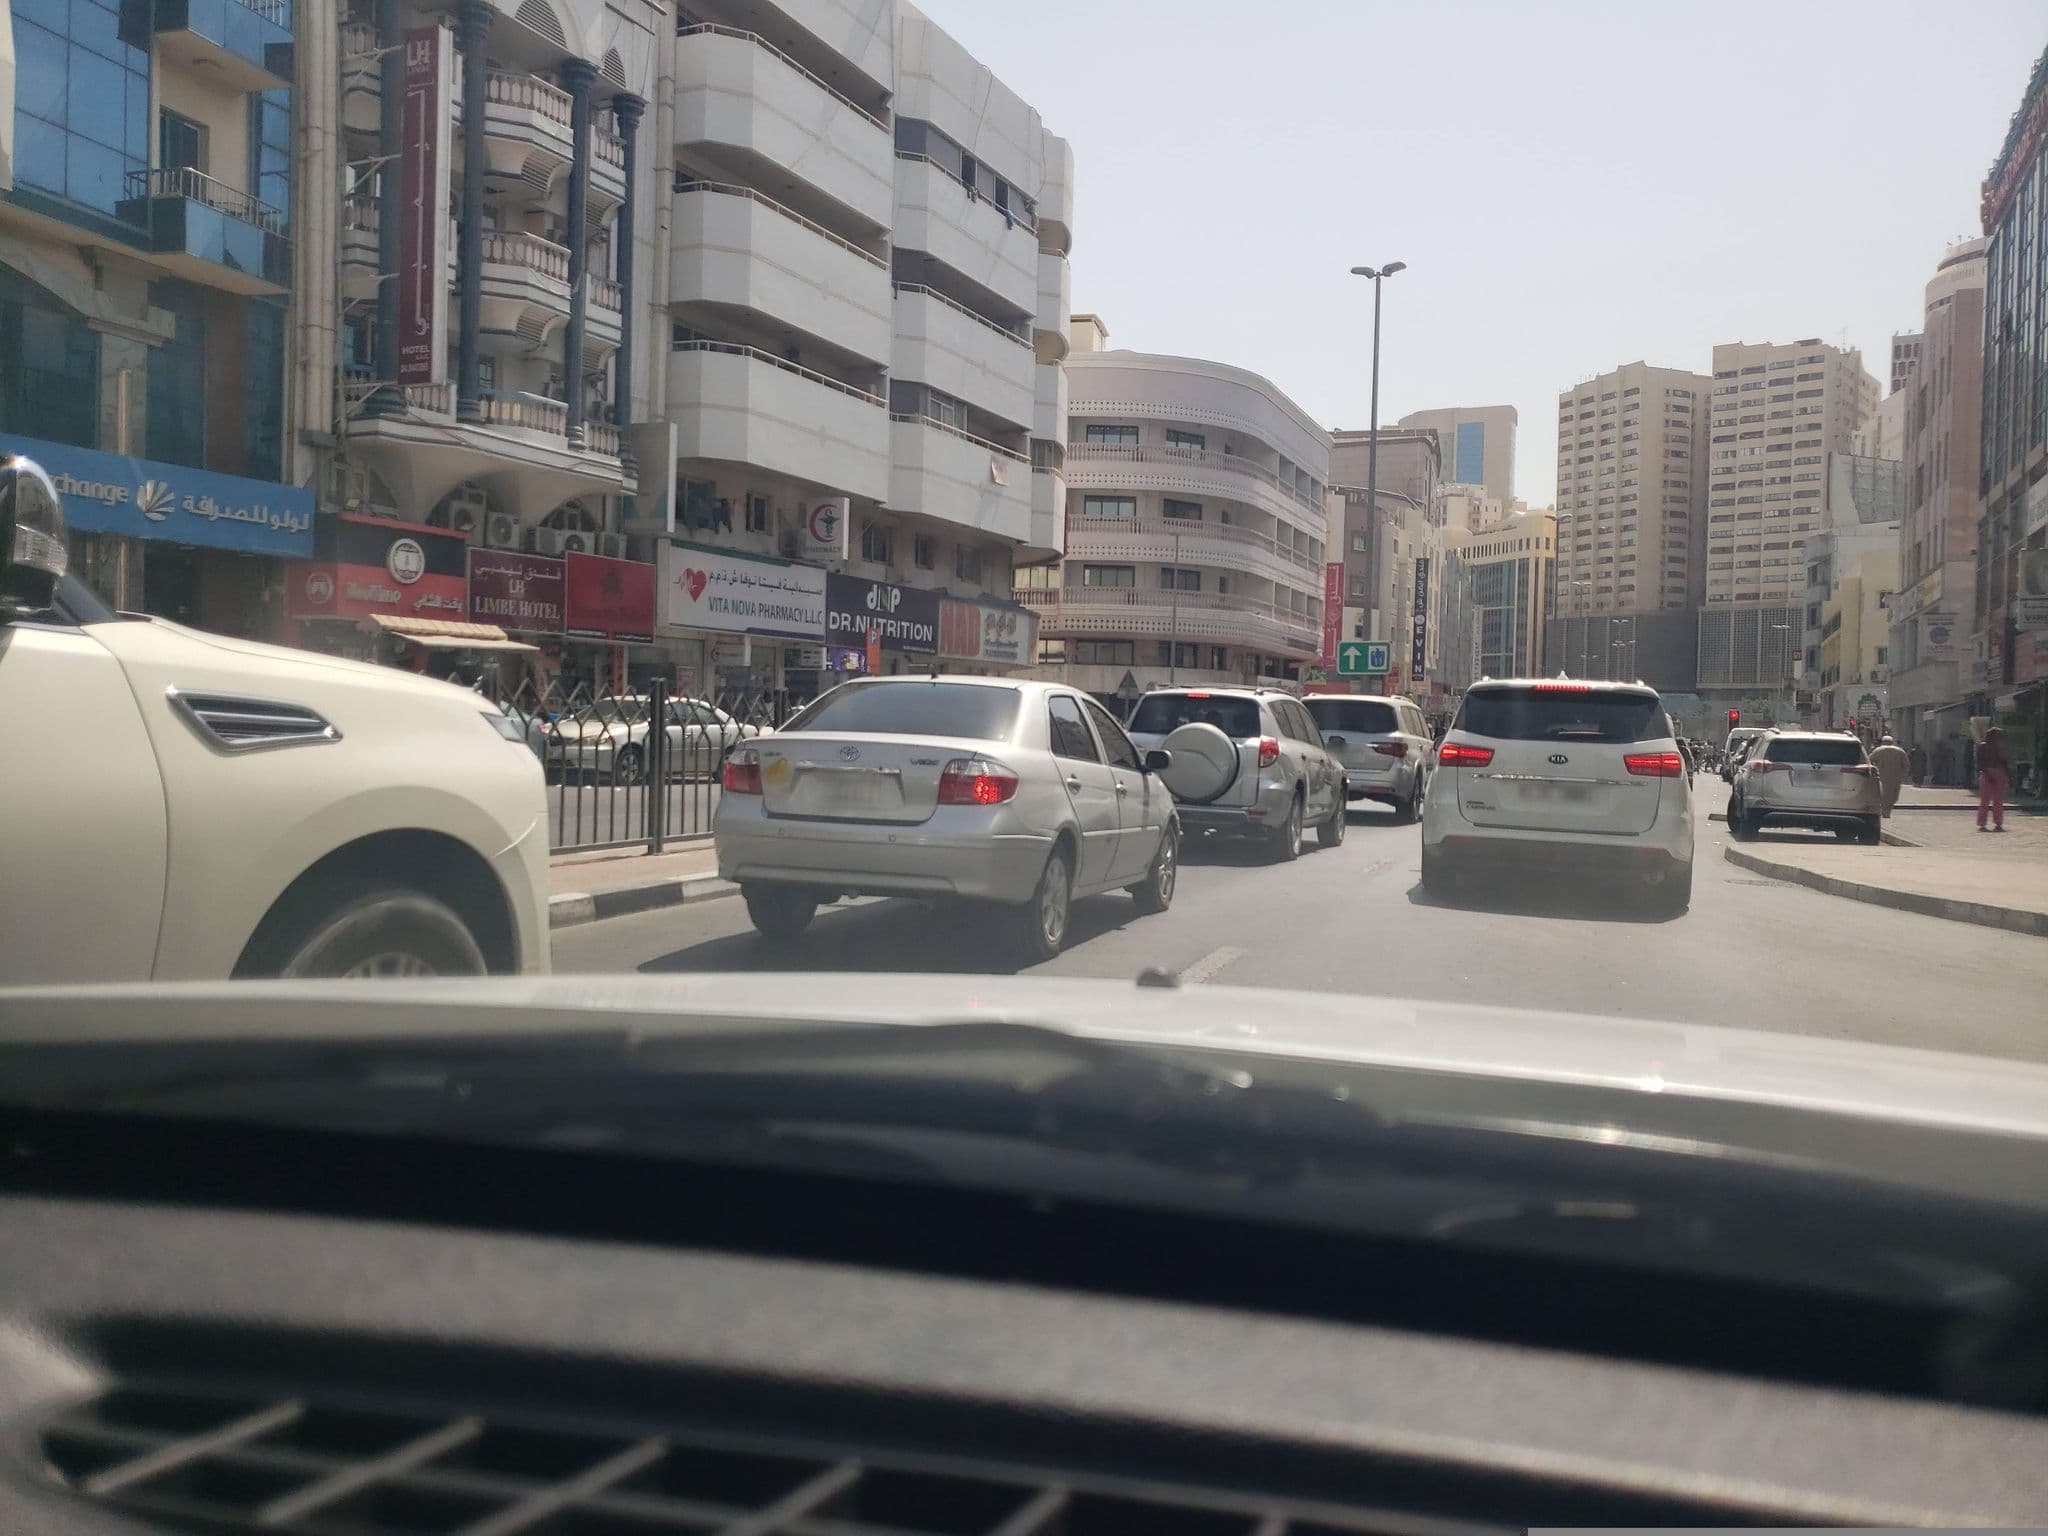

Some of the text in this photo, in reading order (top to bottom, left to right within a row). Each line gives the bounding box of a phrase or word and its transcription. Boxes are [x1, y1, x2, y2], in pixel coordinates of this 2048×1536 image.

[401, 344, 430, 354] HOTEL
[51, 474, 128, 507] change
[270, 509, 310, 533] لولو
[475, 596, 517, 616] LIMBE
[519, 600, 560, 619] HOTEL
[708, 595, 729, 614] VITA
[732, 599, 756, 617] NOVA
[758, 602, 803, 623] PHARMACY
[1550, 755, 1567, 764] KIA
